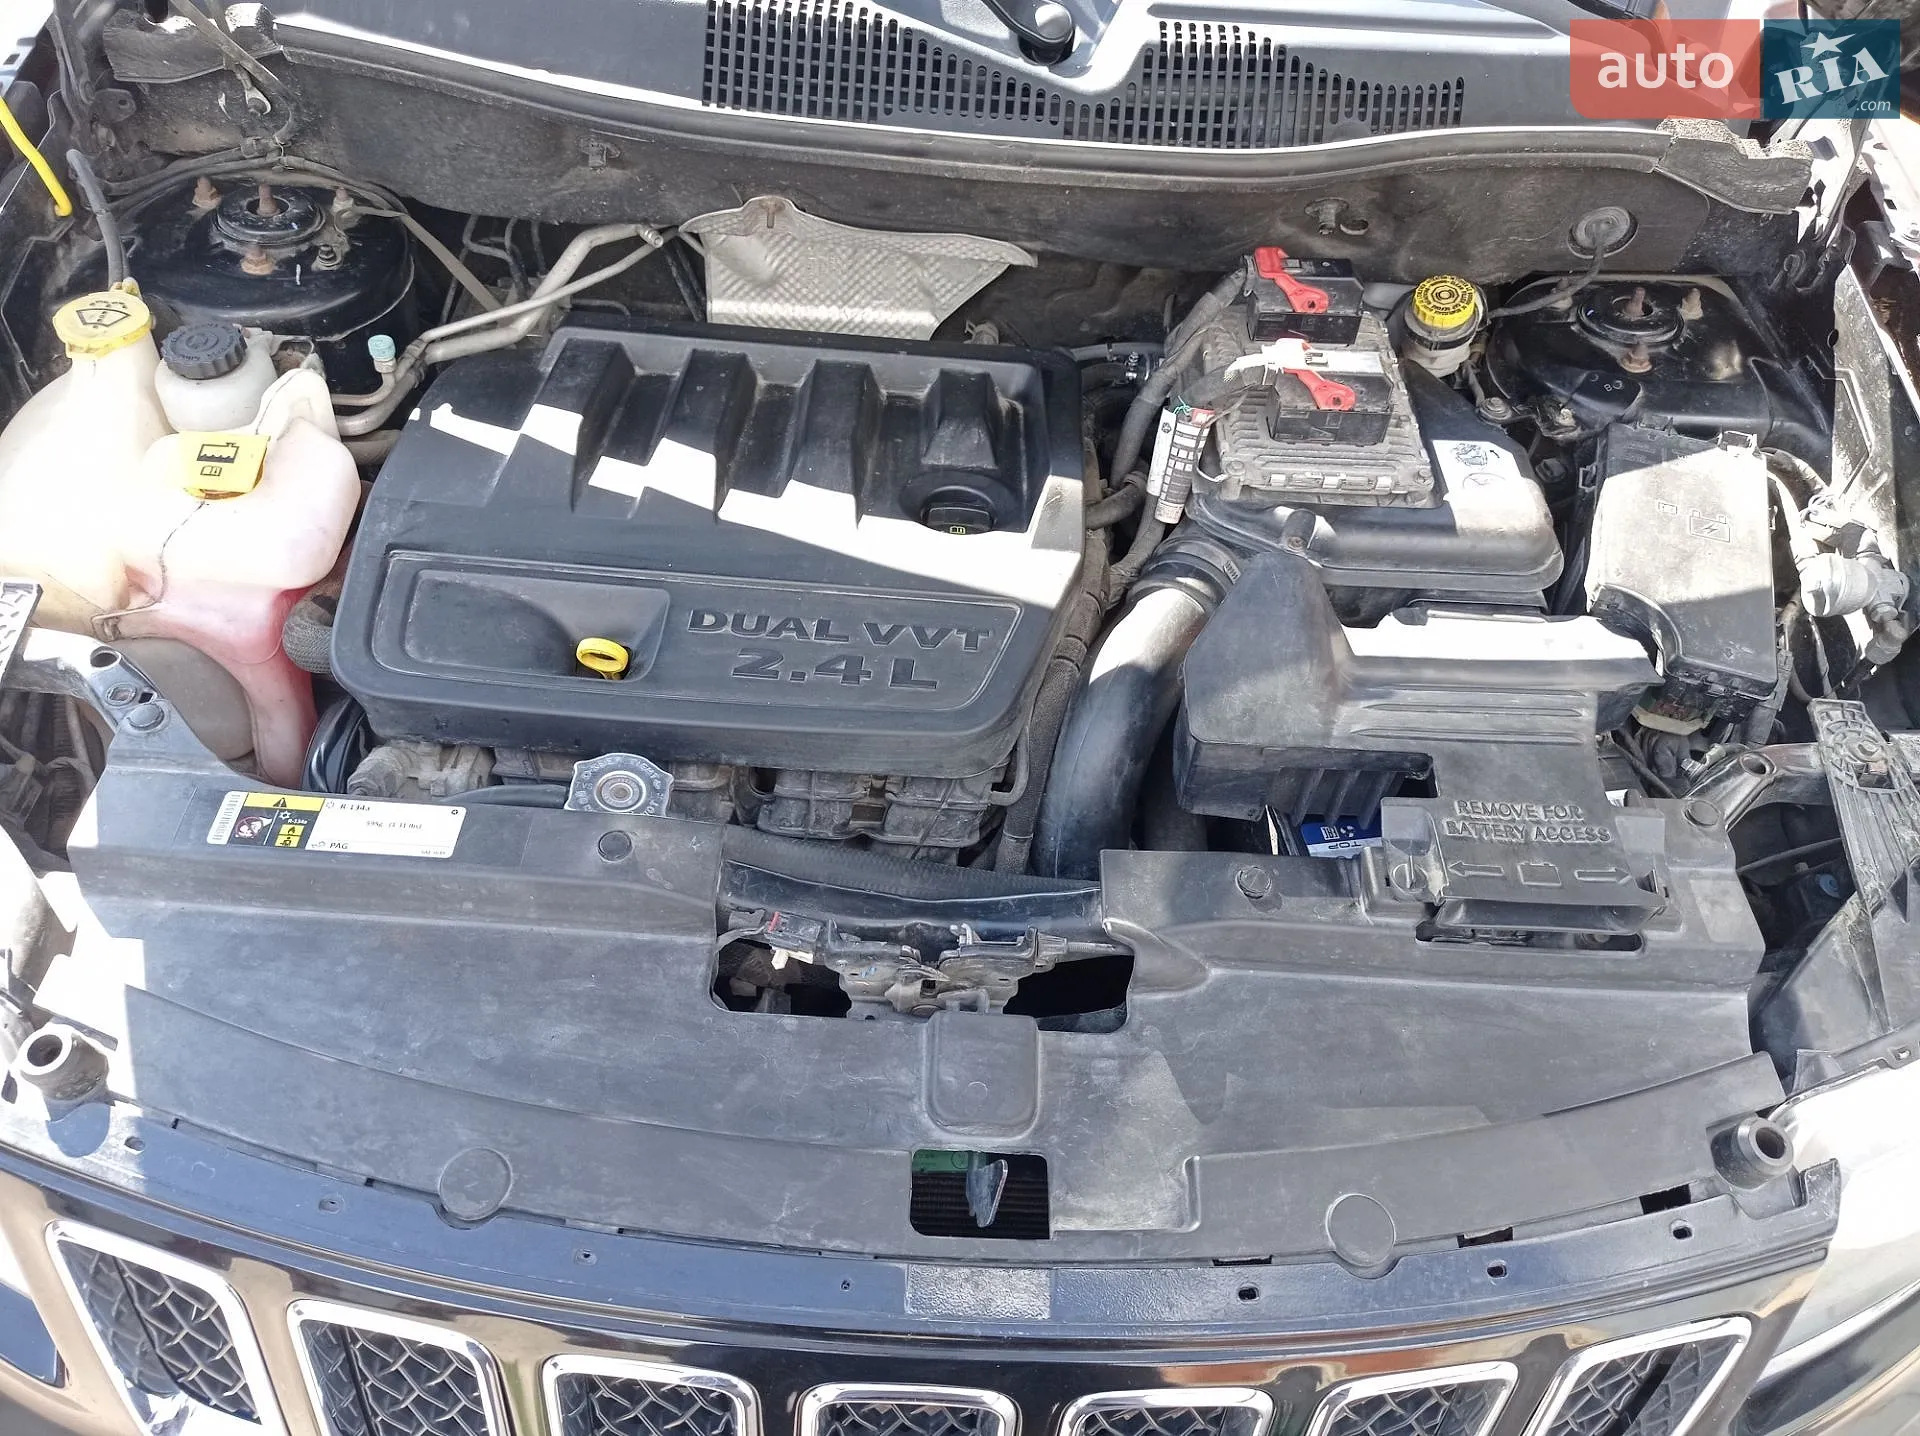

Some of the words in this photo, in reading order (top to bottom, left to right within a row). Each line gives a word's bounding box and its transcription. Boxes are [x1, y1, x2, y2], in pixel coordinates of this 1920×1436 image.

[688, 609, 849, 643] DUAL
[863, 622, 991, 652] VVT
[1454, 801, 1539, 821] REMOVE
[1542, 804, 1585, 821] FOR
[1444, 820, 1526, 841] BATTERY
[1534, 826, 1612, 843] ACCESS
[329, 841, 349, 850] PAG
